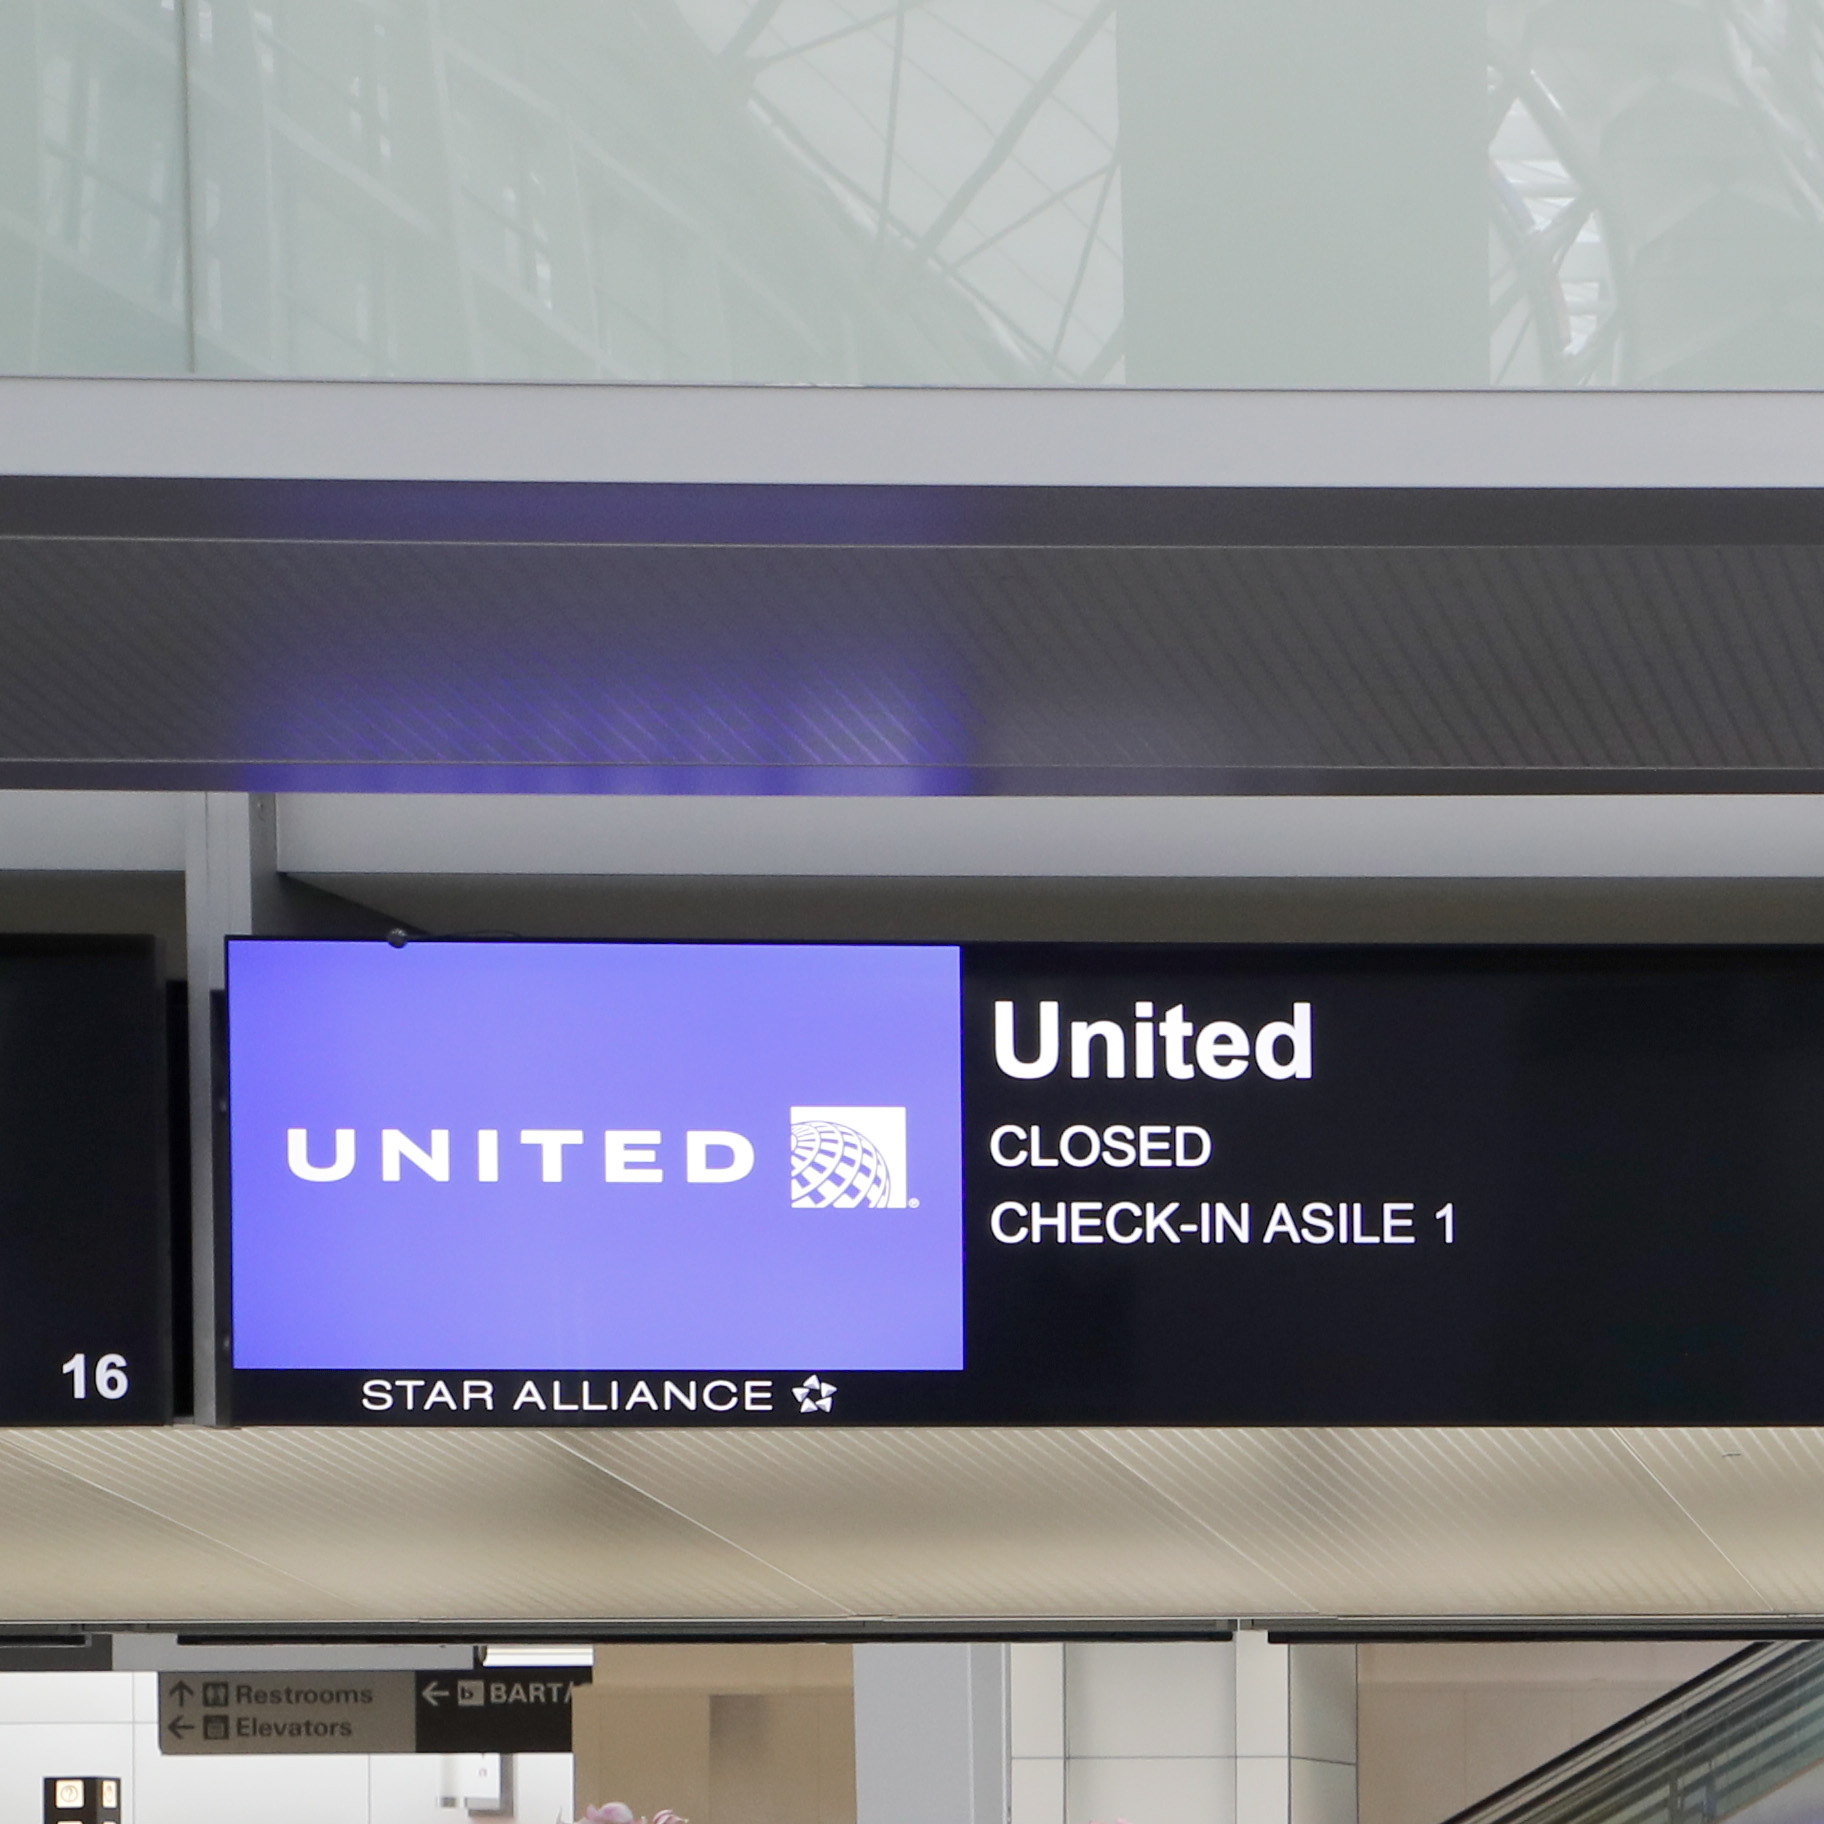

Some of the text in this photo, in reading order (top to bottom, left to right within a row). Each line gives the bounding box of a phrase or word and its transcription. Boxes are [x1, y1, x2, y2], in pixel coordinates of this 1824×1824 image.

[994, 1000, 1312, 1080] United
[287, 1128, 756, 1184] UNITED
[989, 1124, 1212, 1168] CLOSED
[990, 1200, 1454, 1245] CHECK-IN ASILE 1
[61, 1353, 129, 1401] 16
[361, 1379, 774, 1412] STAR ALLIANCE
[235, 1683, 374, 1705] Restrooms
[236, 1717, 353, 1738] Elevators
